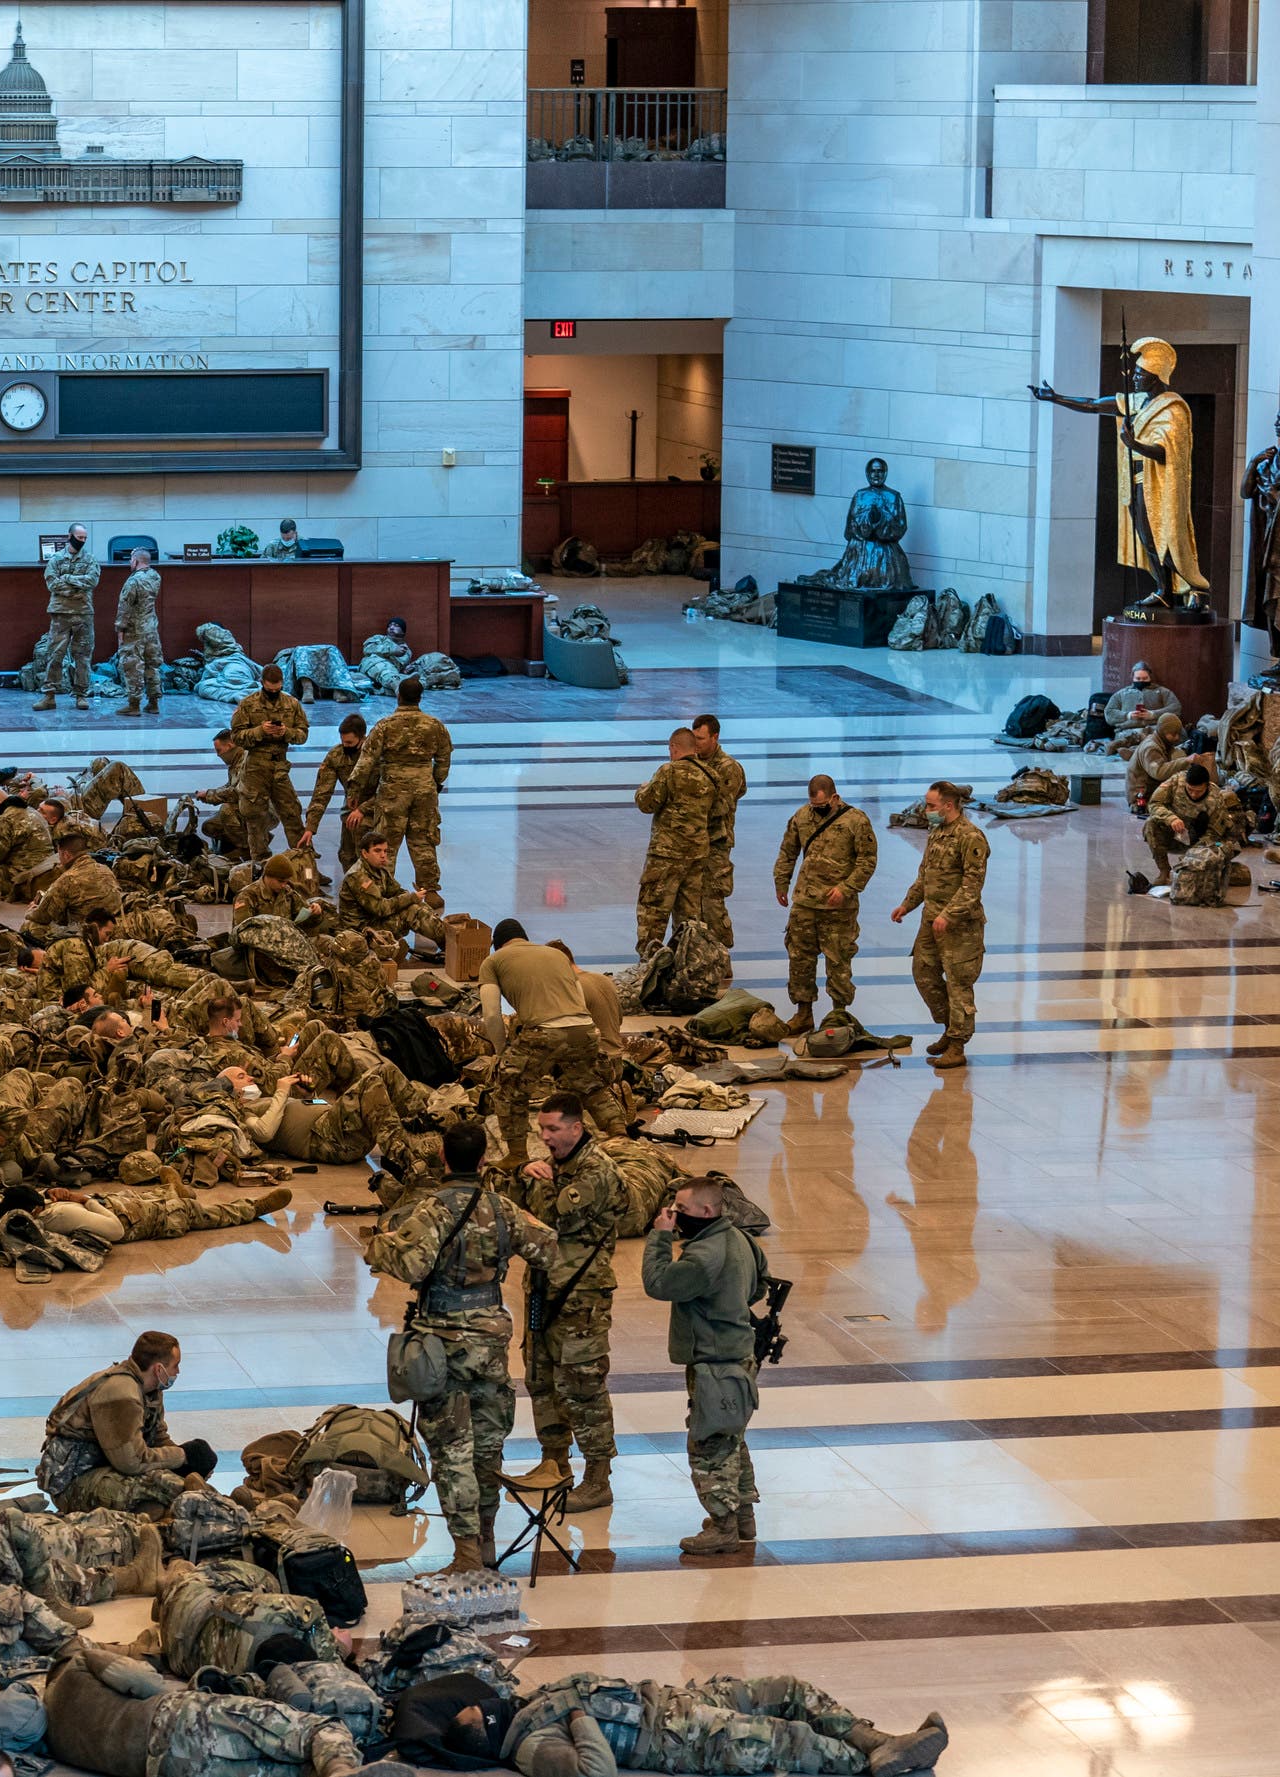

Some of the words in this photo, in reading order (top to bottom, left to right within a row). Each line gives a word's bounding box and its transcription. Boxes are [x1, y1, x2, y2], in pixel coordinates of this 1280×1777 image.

[70, 261, 194, 283] CAPITOL
[25, 291, 137, 314] CENTER
[554, 321, 574, 337] EXIT
[1, 355, 45, 371] AND
[57, 354, 209, 371] INFORMATION
